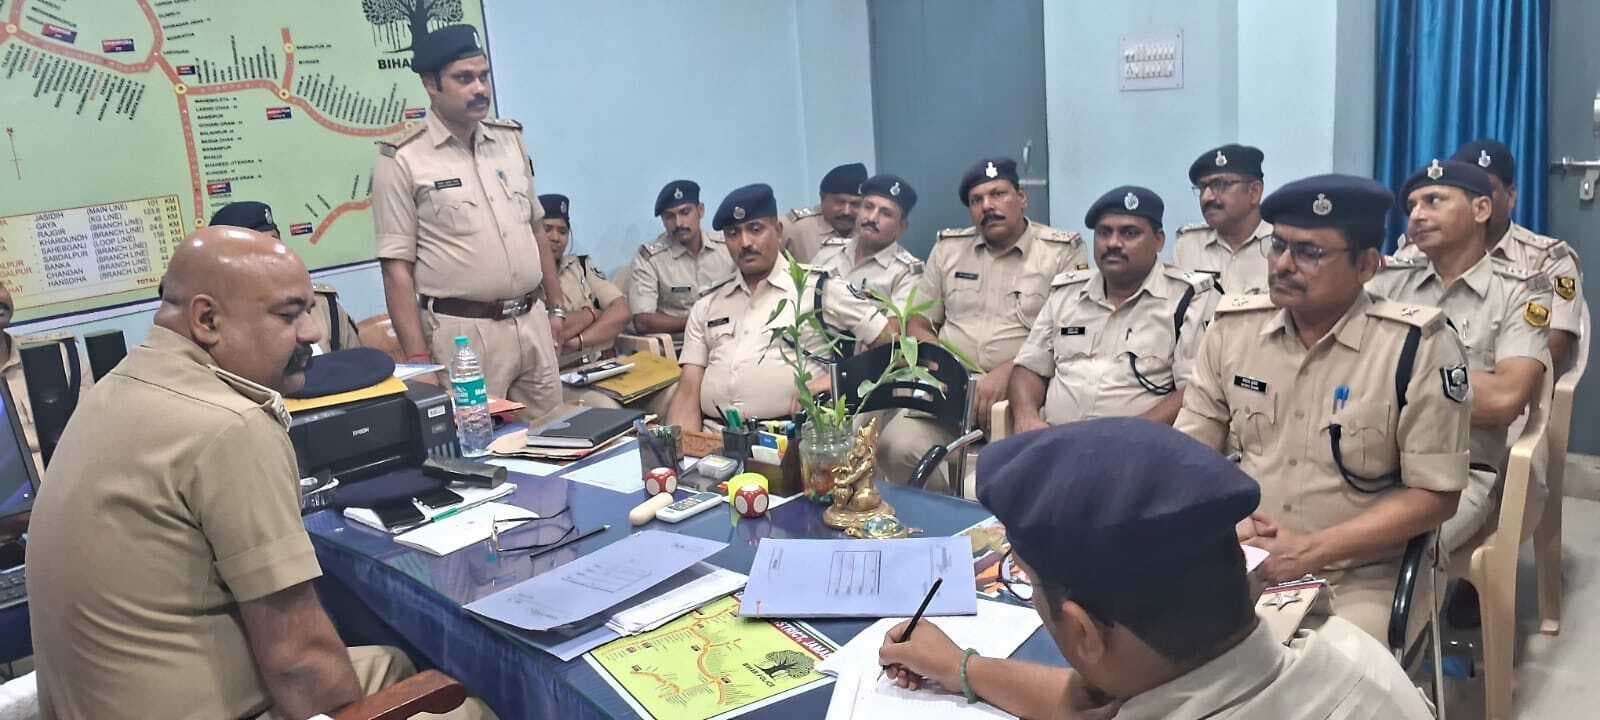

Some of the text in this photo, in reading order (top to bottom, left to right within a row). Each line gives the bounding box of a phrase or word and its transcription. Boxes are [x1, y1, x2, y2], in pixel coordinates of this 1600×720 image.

[377, 58, 413, 70] BIHA
[36, 211, 64, 221] JASIDIH
[36, 221, 56, 230] GAYA
[103, 211, 122, 221] LINE)
[166, 204, 177, 212] KM
[37, 228, 66, 238] RAJGIR
[90, 221, 123, 232] (BRANCH
[124, 217, 143, 227] LINE)
[92, 229, 125, 240] (BRANCH
[125, 225, 144, 234] LINE)
[93, 238, 115, 248] (LOOP
[116, 234, 136, 243] LINE)
[170, 227, 181, 235] KM
[95, 245, 128, 256] (BRANCH
[45, 262, 71, 271] BANKA
[97, 253, 129, 264] (BRANCH
[46, 267, 84, 279] CHANDAN
[98, 260, 130, 272] (BRANCH
[48, 275, 87, 287] HANSDIHA
[100, 268, 132, 280] (BRANCH
